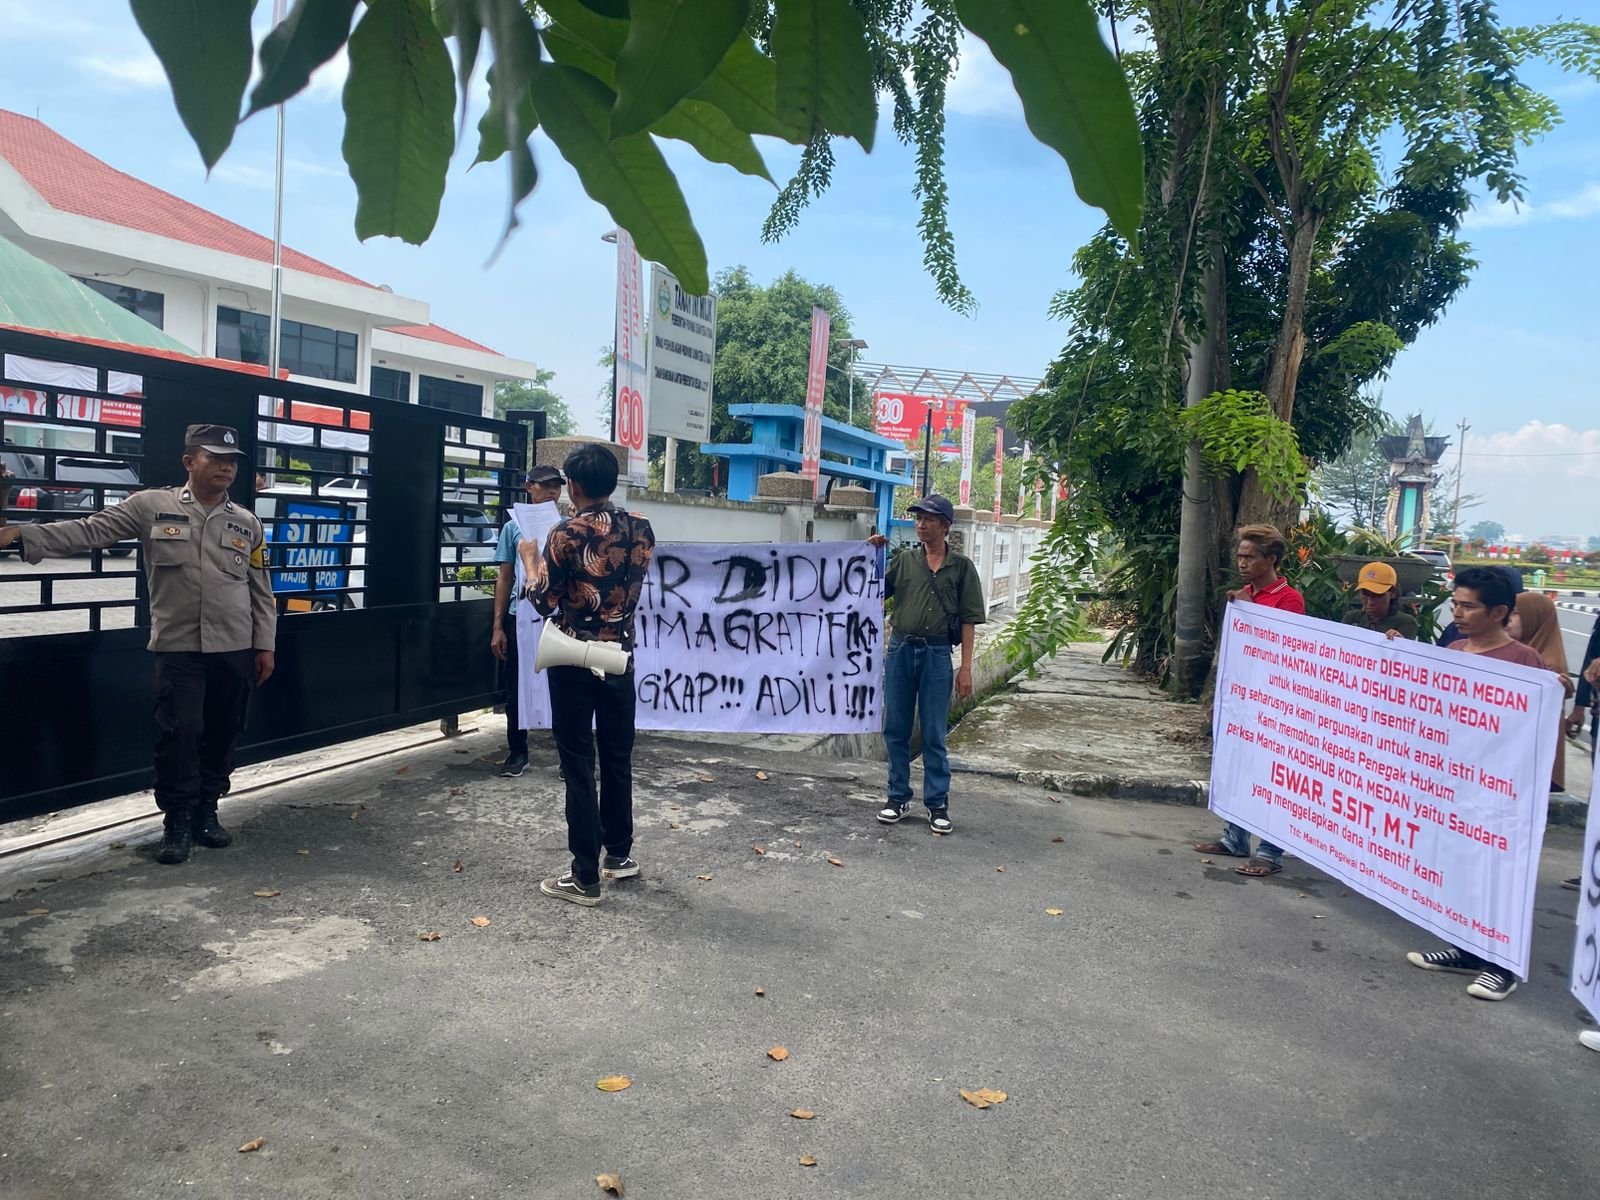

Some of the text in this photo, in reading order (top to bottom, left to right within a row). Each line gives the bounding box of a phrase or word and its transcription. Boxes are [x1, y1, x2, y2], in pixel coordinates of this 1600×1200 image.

[619, 386, 644, 451] 80
[802, 403, 823, 462] 80
[875, 398, 904, 424] 80
[227, 522, 251, 538] POLRI
[286, 548, 336, 567] TAMU
[287, 512, 342, 543] STOP
[280, 571, 308, 584] WAJIB
[1233, 618, 1528, 712] Kami mantan pegawai dan honorer DISHUB KOTA MEDAN
[1244, 644, 1500, 734] menuntut MANTAN KEPALA DISHUB KOTA MEDAN
[1231, 682, 1517, 800] yang seharusnya kami pergunakan untuk anak istri kami,
[1269, 674, 1450, 746] untuk kembalikan uang insentif kami
[1256, 732, 1286, 755] Mantan
[1288, 745, 1335, 778] KADISHUB
[1338, 767, 1363, 791] KOTA
[1366, 780, 1410, 810] MEDAN
[1414, 802, 1445, 826] yaitu
[1449, 813, 1508, 850] Saudara
[1258, 712, 1455, 802] Kami memohon kepada Penegak Hukum
[1251, 783, 1444, 888] yang menggelapkan dana insentif kami
[1271, 761, 1420, 849] ISWAR. S.SIT, M.T
[1303, 832, 1328, 853] Mantan
[1330, 845, 1358, 869] Pegawai
[1360, 862, 1375, 878] Dan
[1378, 873, 1409, 895] Honorer
[1412, 889, 1443, 914] Dishub
[1445, 908, 1469, 927] Kota
[1472, 919, 1510, 945] Medan
